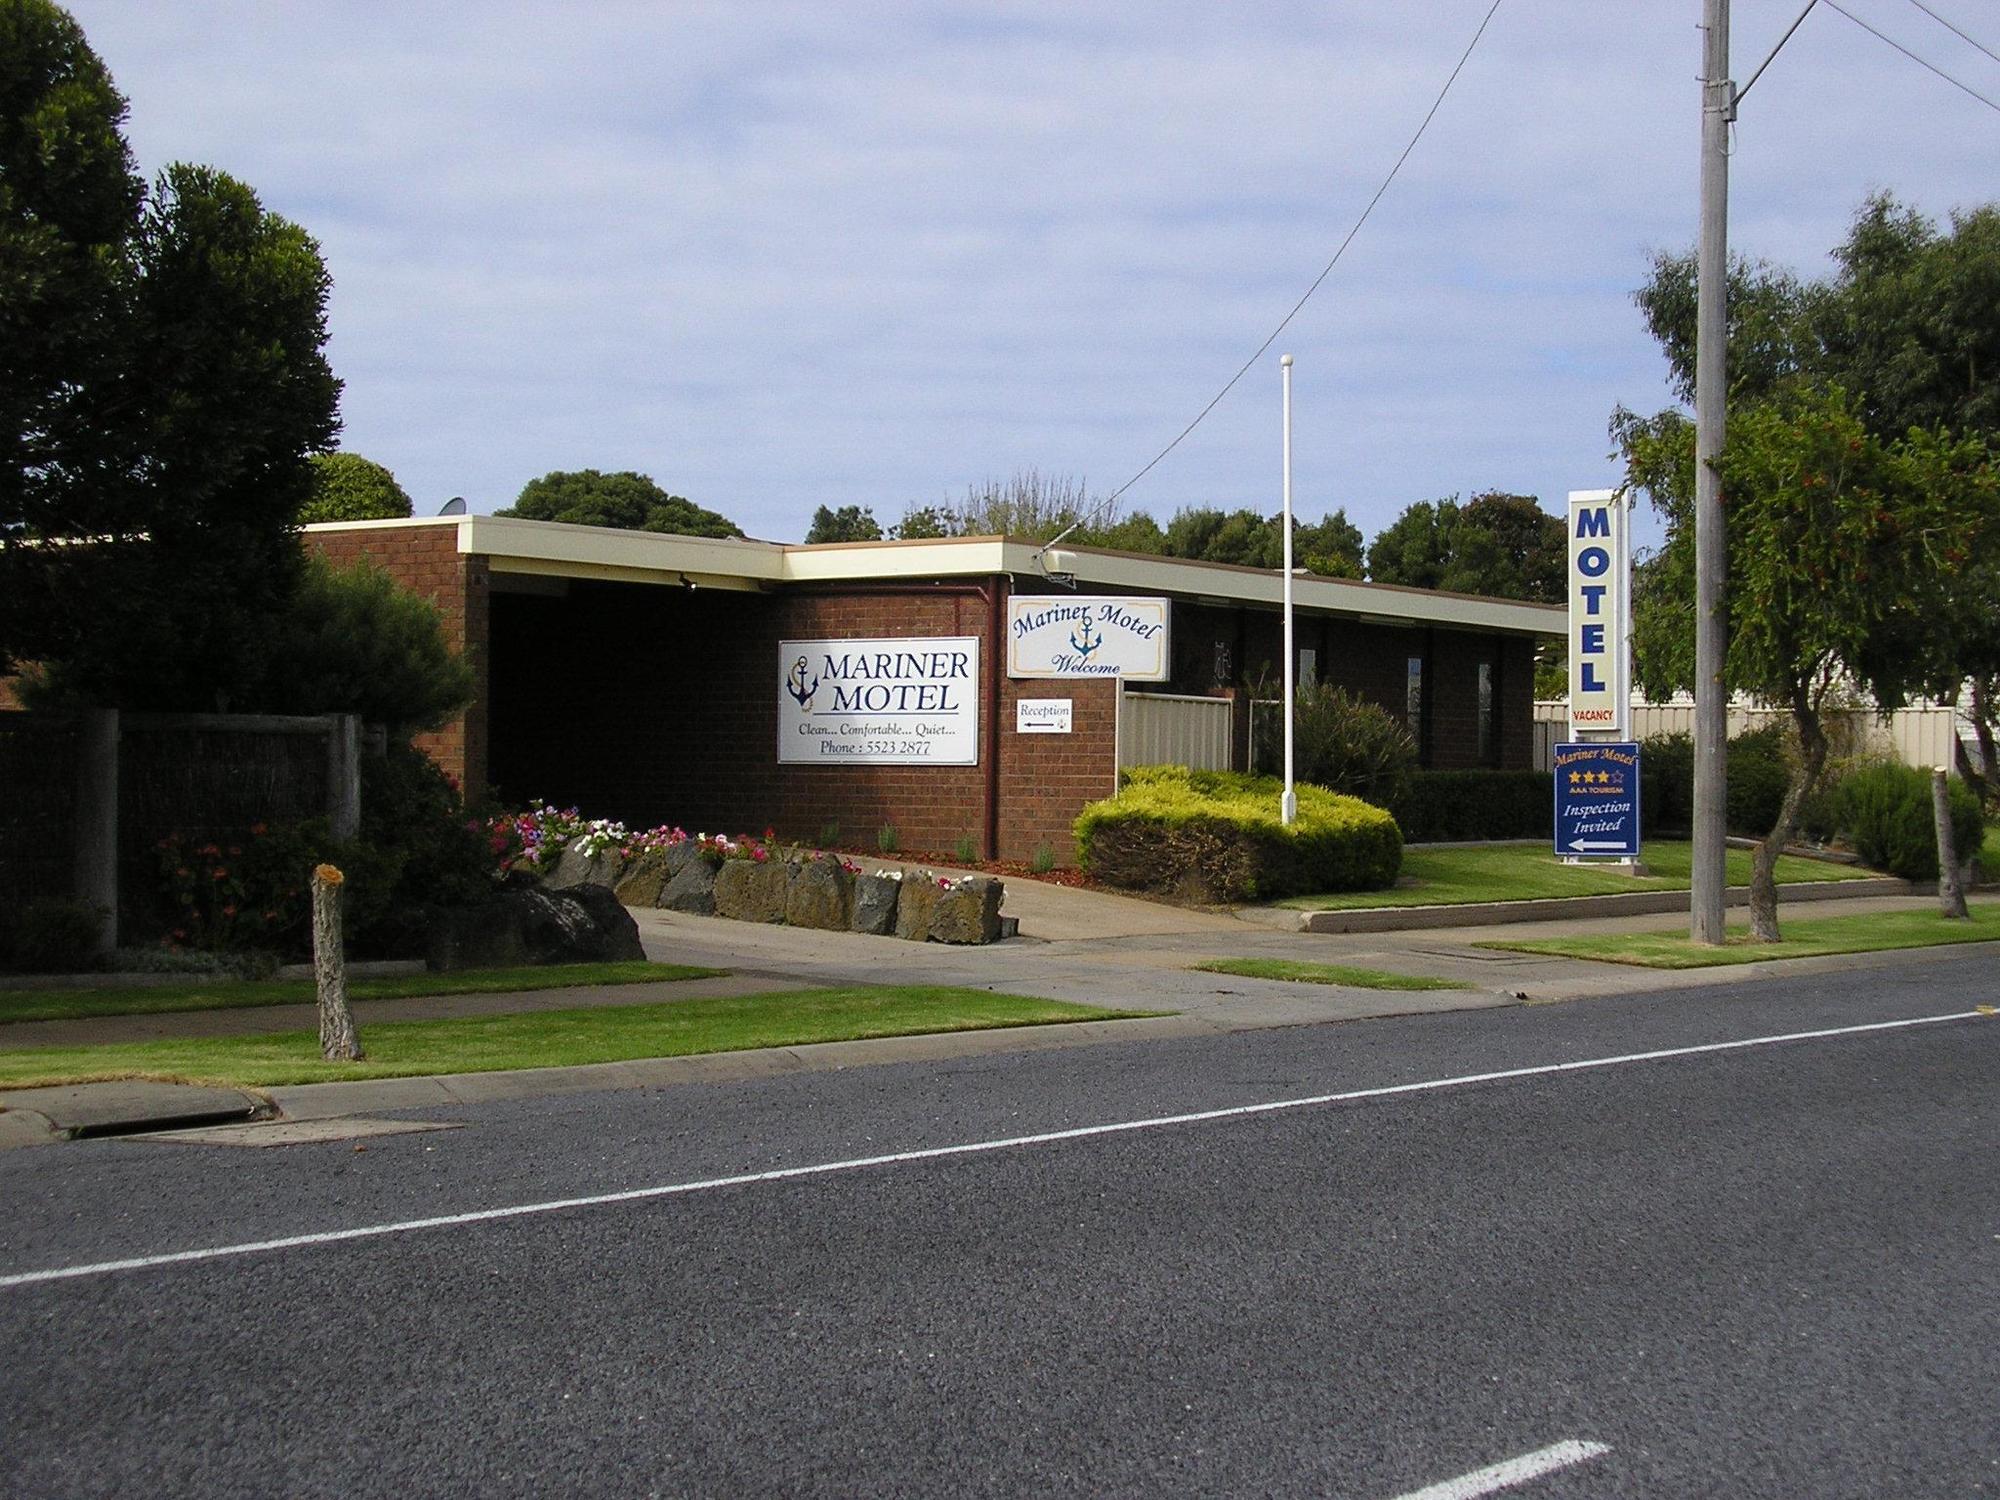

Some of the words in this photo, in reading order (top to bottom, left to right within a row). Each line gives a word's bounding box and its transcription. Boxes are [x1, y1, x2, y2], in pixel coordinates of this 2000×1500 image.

[1576, 508, 1611, 692] MOTEL
[1013, 603, 1091, 639] Mariner
[1098, 604, 1162, 640] Motel
[822, 652, 969, 680] MARINER
[1051, 654, 1120, 674] Welcome
[831, 684, 959, 711] MOTEL
[1020, 704, 1069, 718] Reception
[1573, 710, 1614, 722] VACANCY
[799, 723, 838, 736] Clean...
[840, 723, 912, 737] Comfortable...
[915, 723, 956, 736] Quiet...
[820, 741, 855, 754] Phone
[867, 741, 895, 754] 5523
[901, 741, 931, 754] 2877
[1554, 748, 1599, 768] Mariner
[1600, 748, 1639, 766] Motel
[1563, 801, 1631, 819] Inspection
[1573, 816, 1626, 834] Invited
